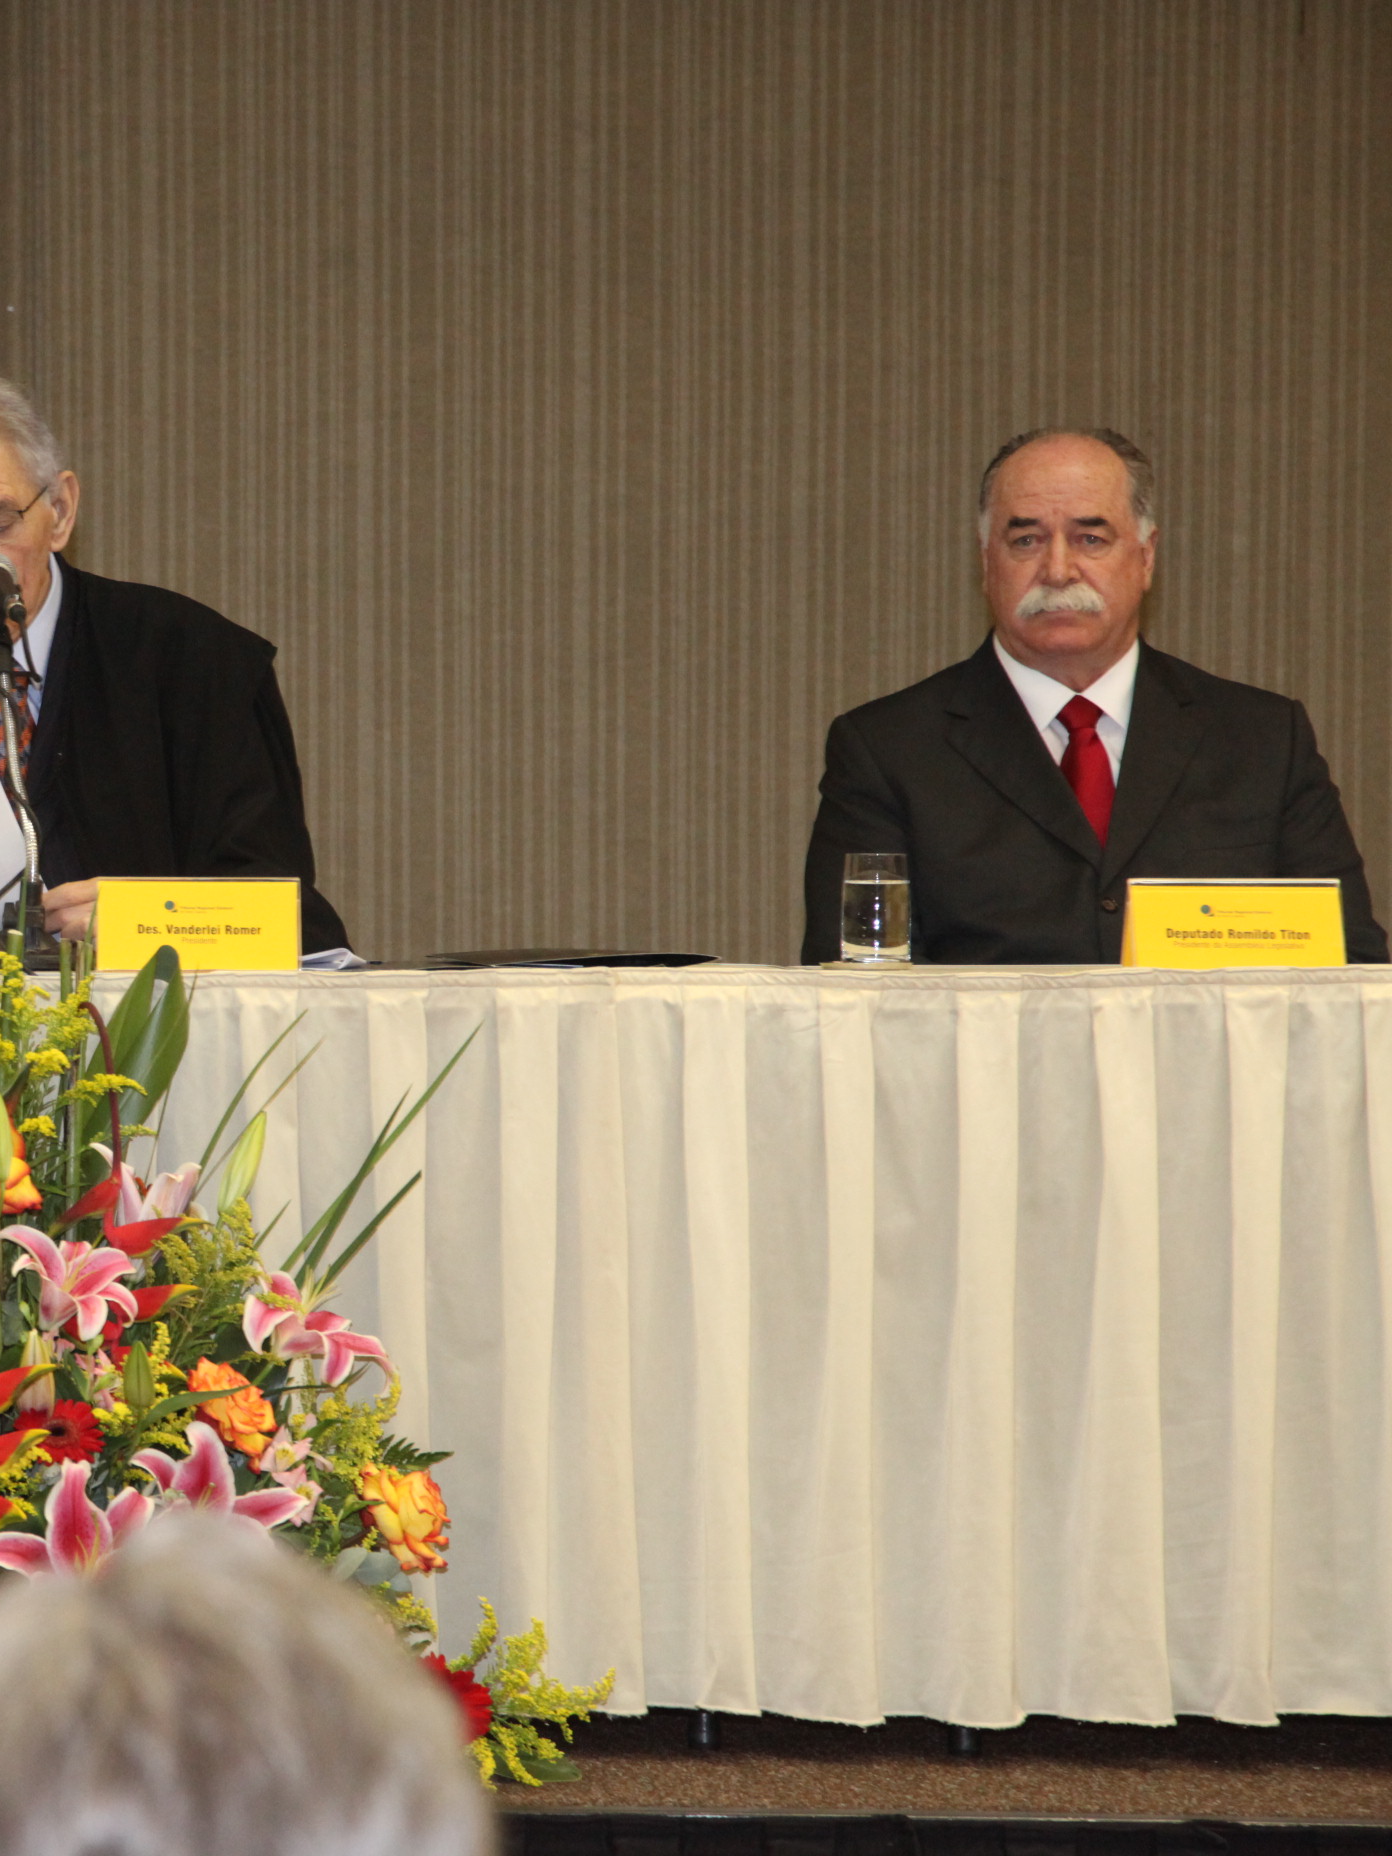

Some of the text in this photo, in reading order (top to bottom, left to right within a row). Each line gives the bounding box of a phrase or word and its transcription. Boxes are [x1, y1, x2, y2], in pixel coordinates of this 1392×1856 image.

[137, 923, 261, 935] Des. Vanderlei Romer
[1166, 928, 1311, 940] Deputado Romildo Titon
